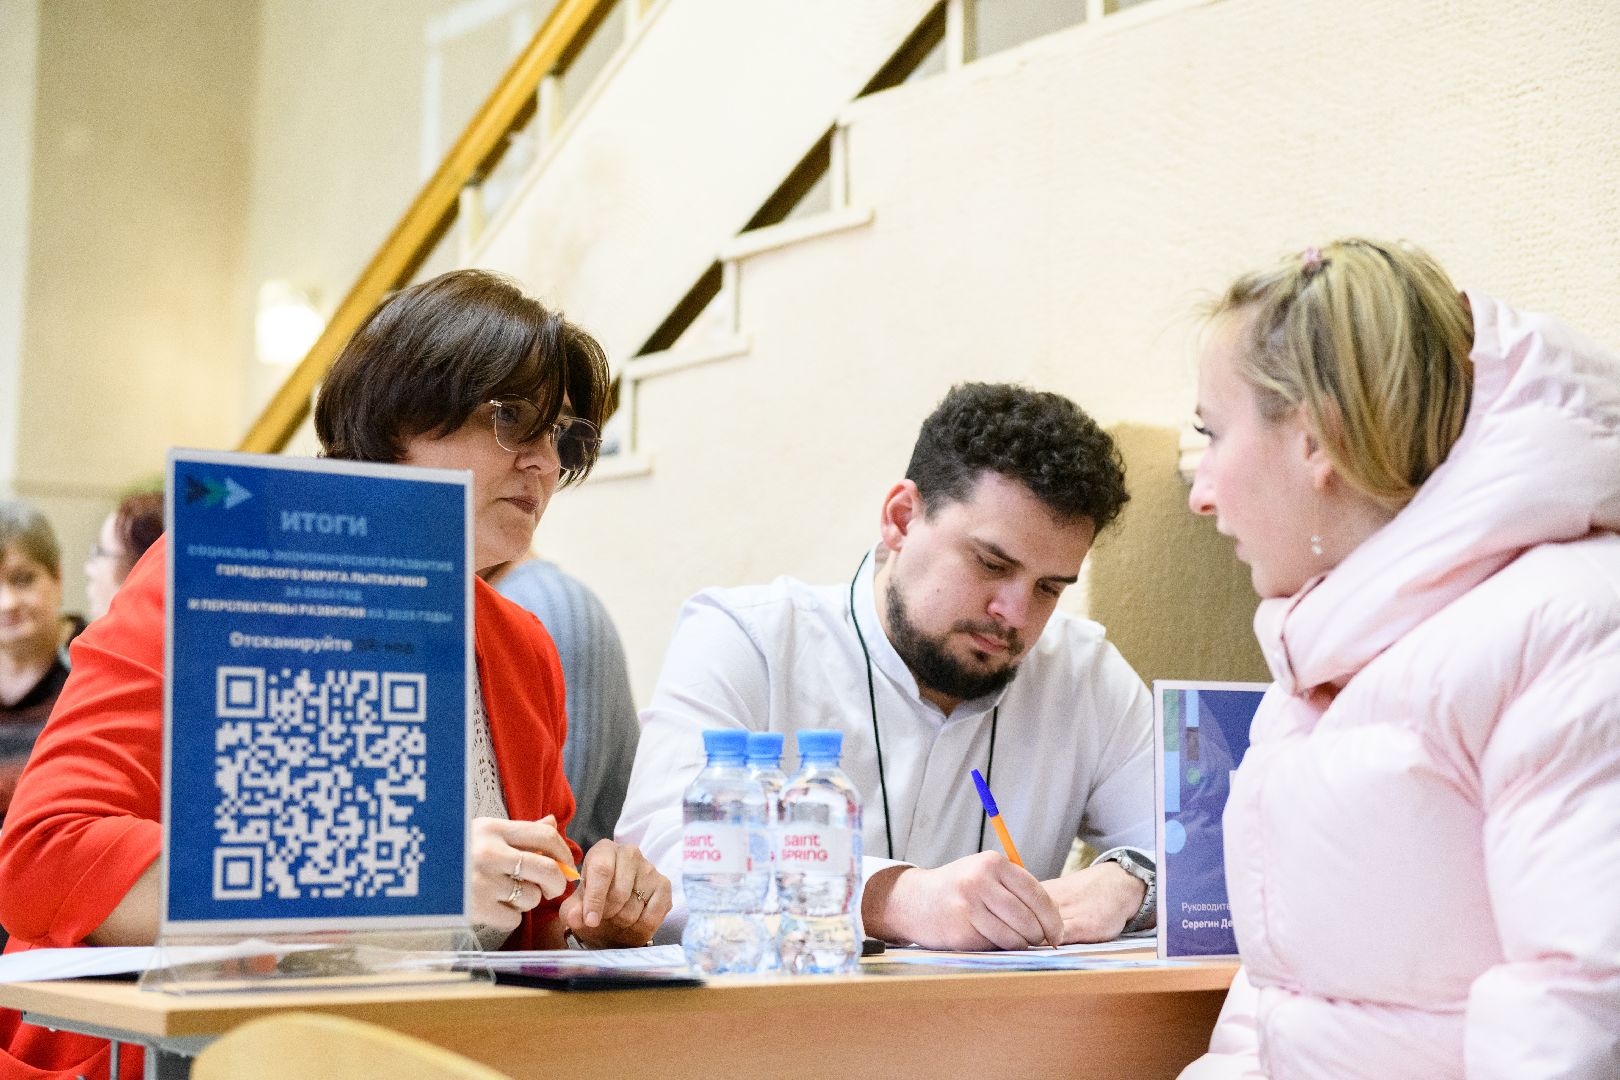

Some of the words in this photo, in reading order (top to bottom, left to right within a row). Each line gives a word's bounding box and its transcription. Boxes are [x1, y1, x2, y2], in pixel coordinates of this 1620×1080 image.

[280, 510, 368, 537] ИТОГИ
[216, 563, 299, 580] ГОРОДСКОГО
[300, 569, 349, 583] ОКРУГА
[229, 631, 353, 654] Отсканируйте
[1182, 919, 1219, 930] Серегин
